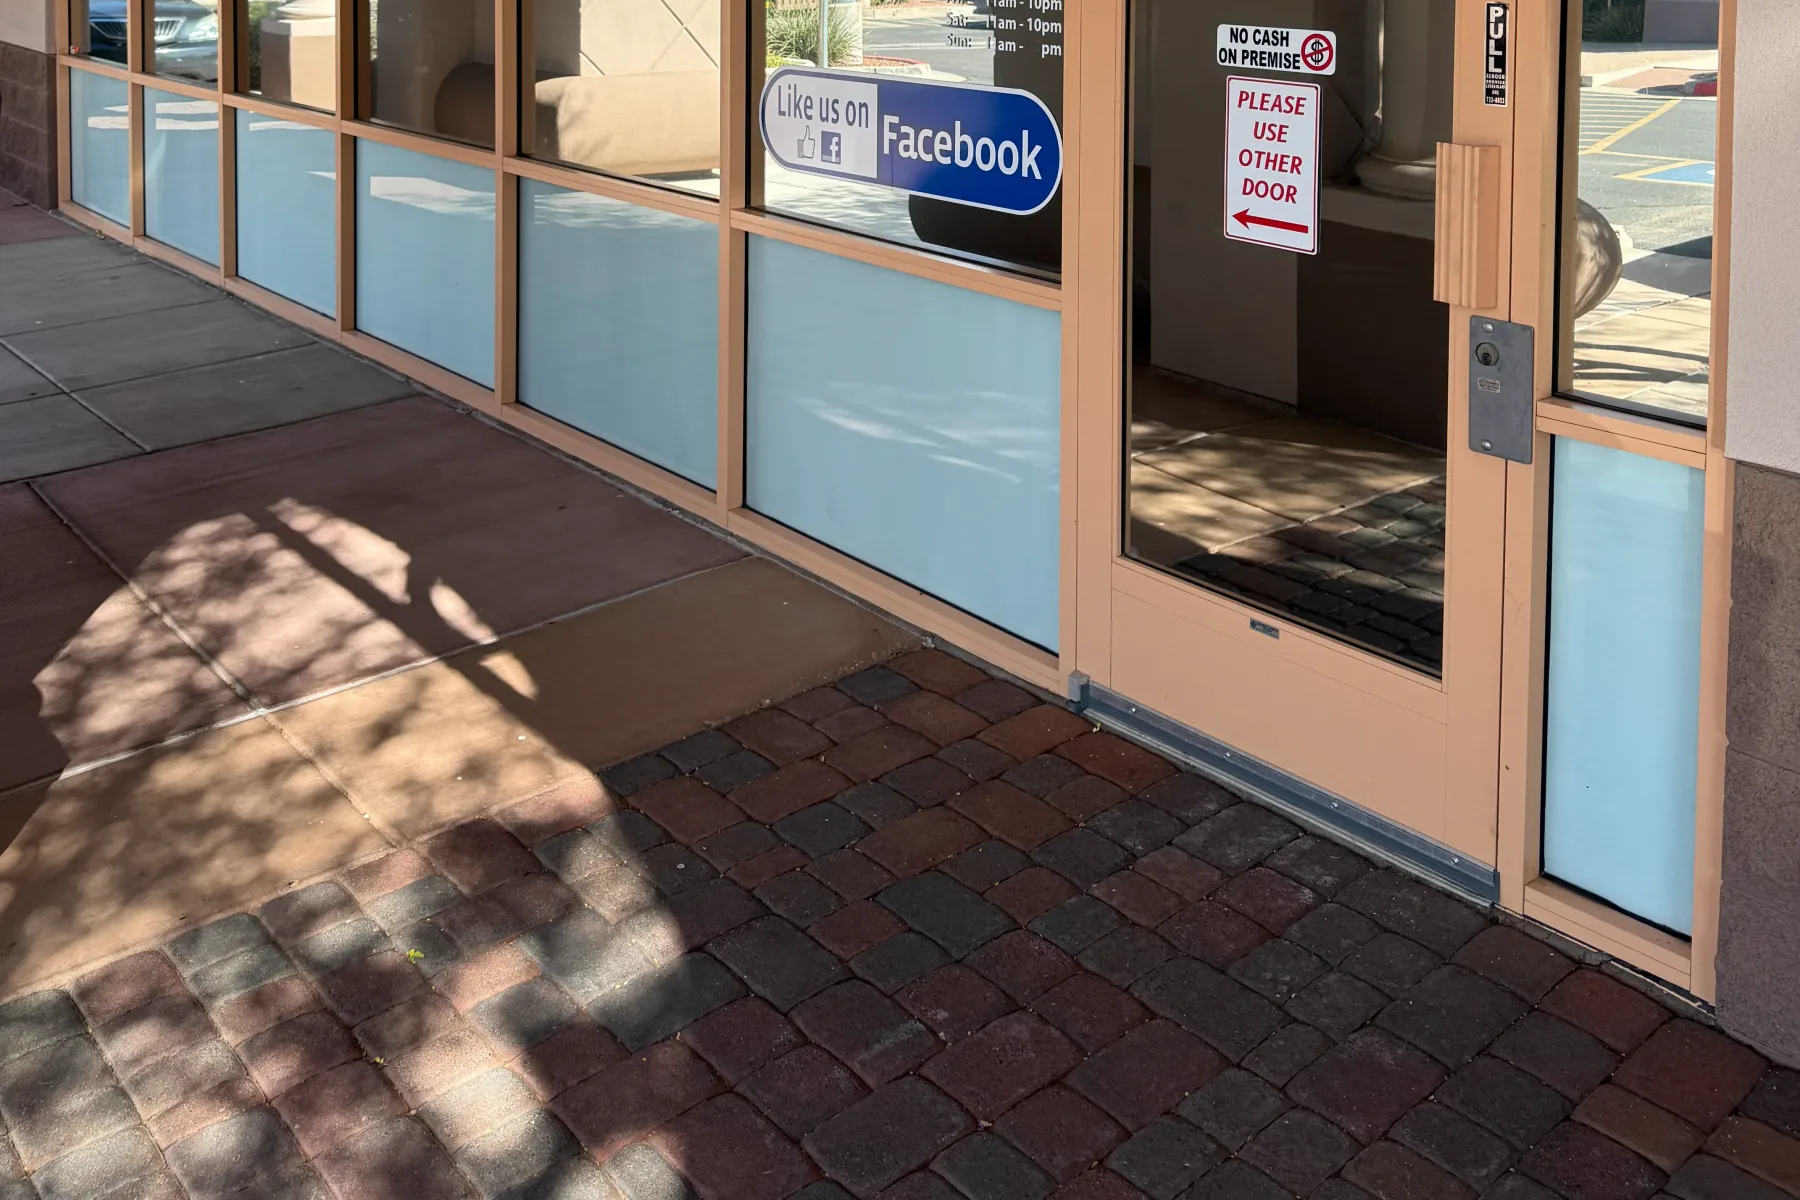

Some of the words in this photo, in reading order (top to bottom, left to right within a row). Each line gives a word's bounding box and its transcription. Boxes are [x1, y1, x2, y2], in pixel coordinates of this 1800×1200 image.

[946, 12, 968, 26] Sat:
[986, 15, 1017, 30] 11am
[1027, 17, 1062, 36] 10pm
[946, 33, 972, 47] Sun:
[1041, 44, 1062, 58] pm
[1229, 27, 1249, 44] NO
[1252, 29, 1290, 47] CASH
[1489, 6, 1504, 73] PULL
[1218, 47, 1237, 64] ON
[1241, 49, 1300, 70] PREMISE
[776, 84, 813, 120] Like
[819, 97, 840, 125] us
[845, 100, 869, 128] on
[1237, 90, 1307, 115] PLEASE
[1253, 121, 1289, 143] USE
[883, 114, 1042, 180] Facebook
[1238, 148, 1303, 175] OTHER
[1242, 177, 1297, 204] DOOR
